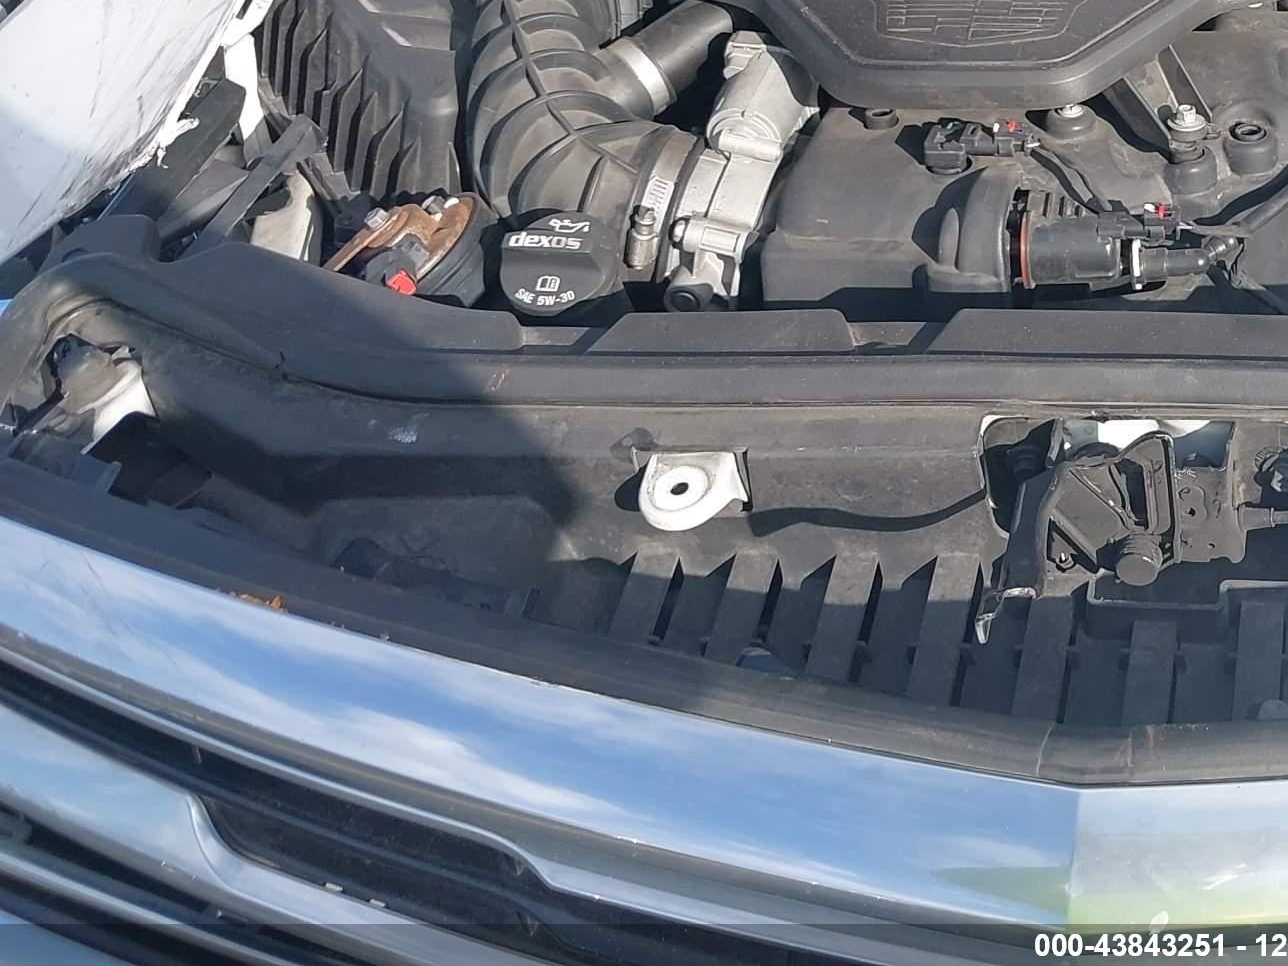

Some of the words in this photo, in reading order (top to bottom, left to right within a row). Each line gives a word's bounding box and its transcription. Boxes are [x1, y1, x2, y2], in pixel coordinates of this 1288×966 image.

[508, 232, 584, 249] dexos
[515, 288, 535, 304] SAE
[535, 290, 576, 306] 5W-30
